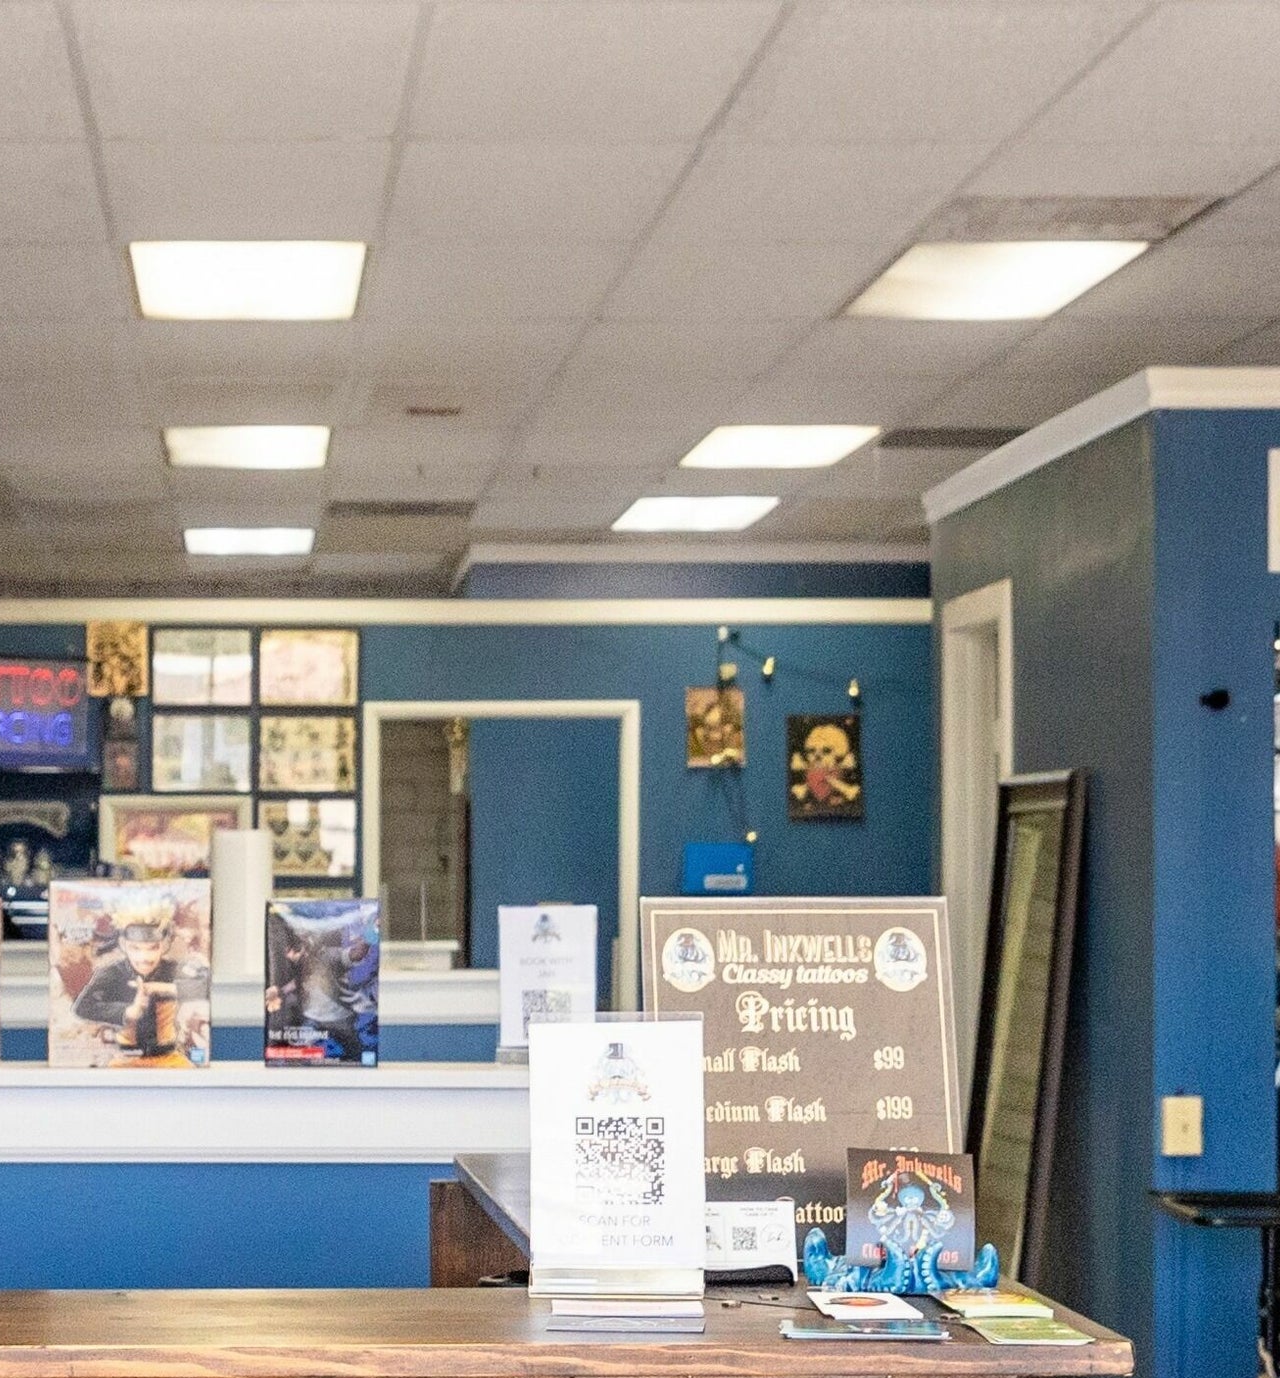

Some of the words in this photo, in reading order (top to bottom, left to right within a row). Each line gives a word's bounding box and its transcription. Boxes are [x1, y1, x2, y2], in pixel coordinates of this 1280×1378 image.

[716, 929, 758, 964] MR.
[763, 929, 873, 964] INKWELLS
[721, 963, 793, 990] Classy
[795, 966, 869, 985] tattoos
[735, 990, 857, 1042] Pricing
[703, 1047, 736, 1074] mall
[739, 1045, 802, 1075] Flash
[873, 1046, 905, 1071] $99
[705, 1099, 761, 1123] edium
[765, 1095, 827, 1125] Flash
[876, 1095, 914, 1121] $199
[703, 1155, 739, 1180] arge
[743, 1146, 807, 1176] Flash
[895, 1154, 963, 1195] Inkwells
[578, 1214, 619, 1227] SCAN
[622, 1214, 651, 1227] FOR
[795, 1201, 848, 1225] attoo
[632, 1234, 674, 1247] FORM
